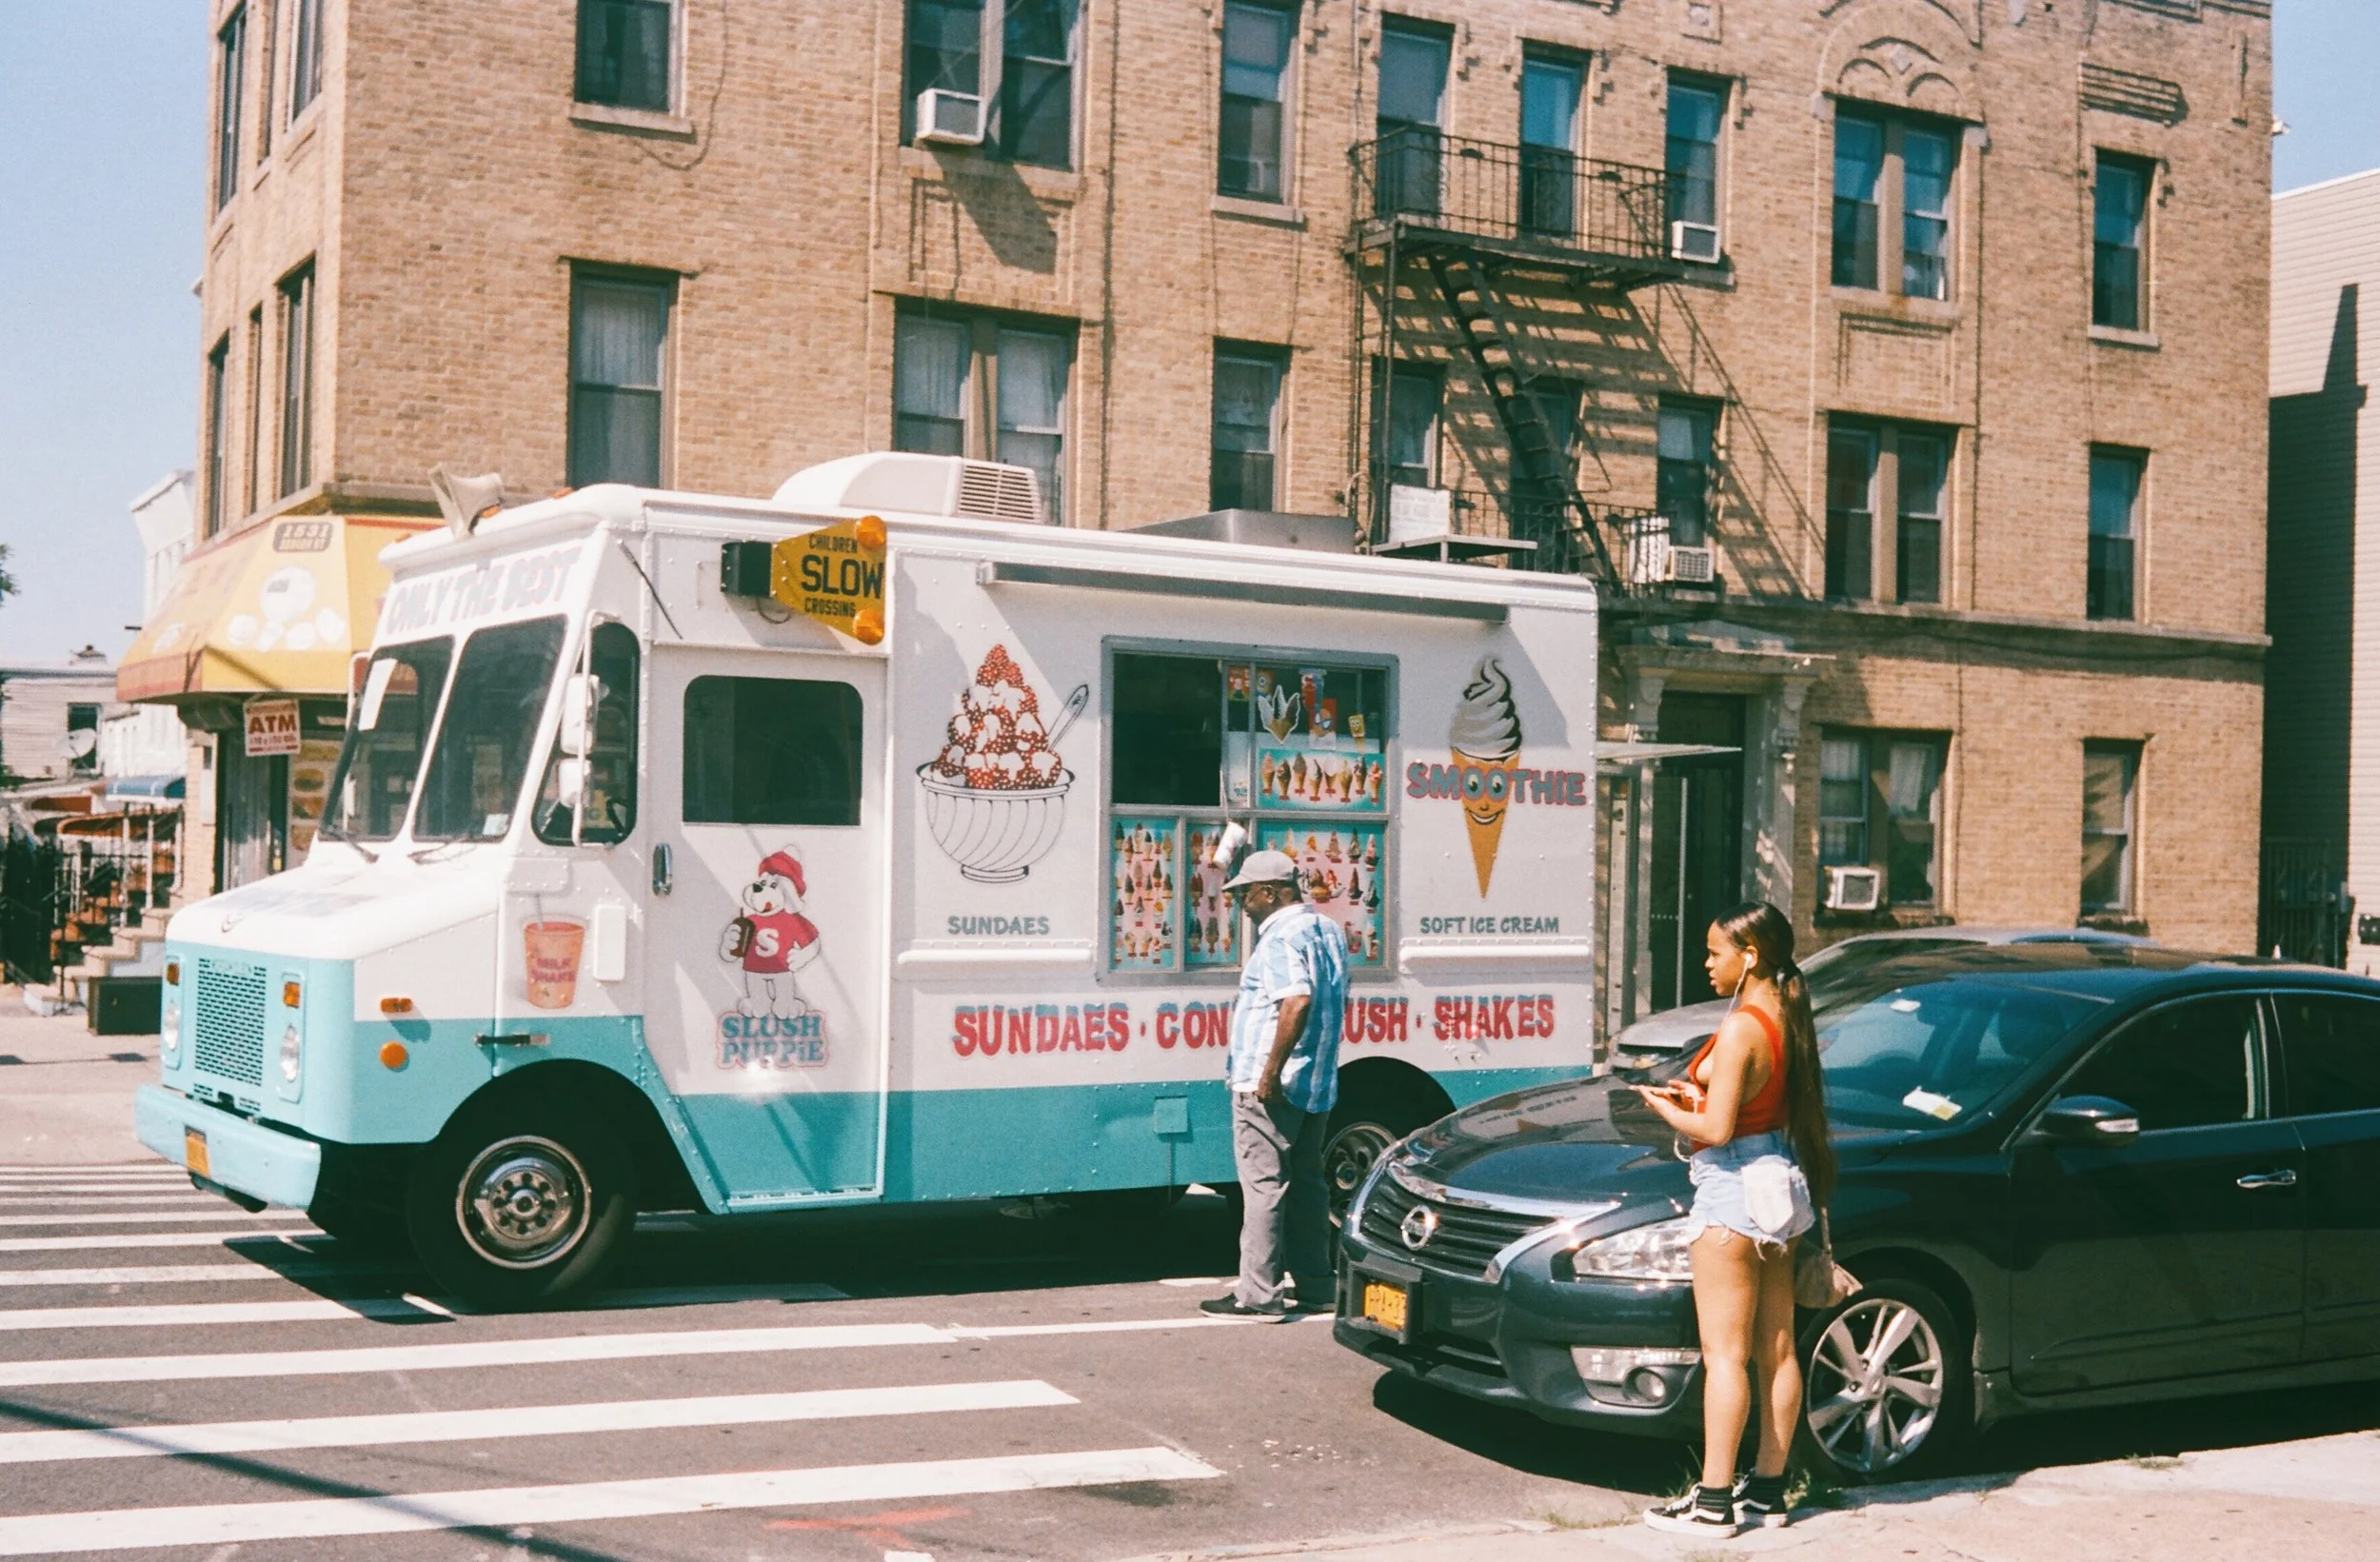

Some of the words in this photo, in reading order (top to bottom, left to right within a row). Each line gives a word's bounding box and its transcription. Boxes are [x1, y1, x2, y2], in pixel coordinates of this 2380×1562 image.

[808, 533, 859, 553] CHILDREN
[801, 554, 884, 599] SLOW
[386, 578, 454, 635] ONLY
[448, 564, 506, 623] THE
[500, 546, 584, 612] BEST
[803, 597, 858, 619] CROSSING
[248, 714, 297, 734] ATM
[1407, 762, 1587, 806] SMOOTHIE
[948, 916, 1049, 935] SUNDAES
[1419, 917, 1466, 933] SOFT
[1469, 917, 1496, 933] ICE
[1499, 917, 1559, 933] CREAM
[755, 928, 780, 957] S
[722, 1014, 823, 1038] SLUSH
[952, 1002, 1130, 1057] SUNDAES
[1156, 1000, 1238, 1050] CON
[1340, 997, 1410, 1045] USH
[1432, 993, 1555, 1041] SHAKES
